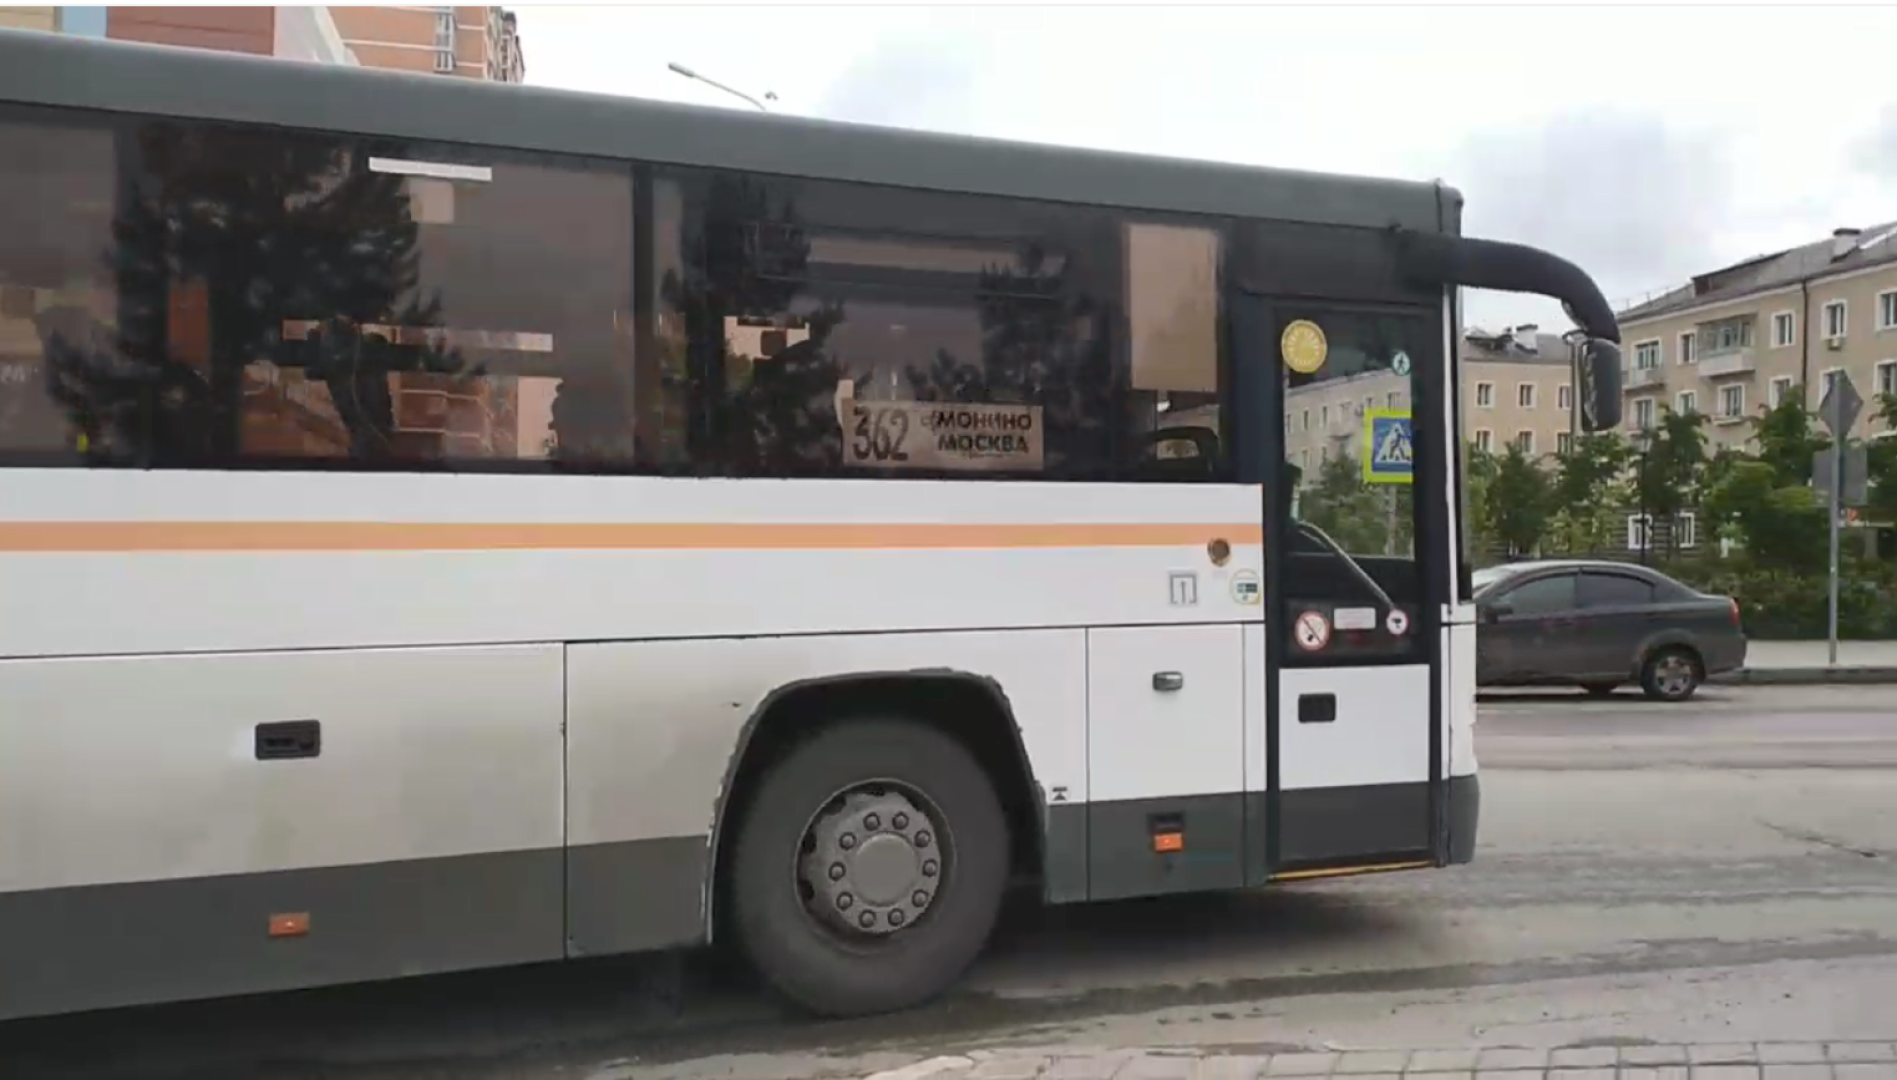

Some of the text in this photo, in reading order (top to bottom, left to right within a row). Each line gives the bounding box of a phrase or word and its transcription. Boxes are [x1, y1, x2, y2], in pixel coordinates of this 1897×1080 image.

[936, 411, 1032, 430] МОНИНО
[853, 405, 909, 461] 362
[938, 435, 1029, 453] МОСКВА
